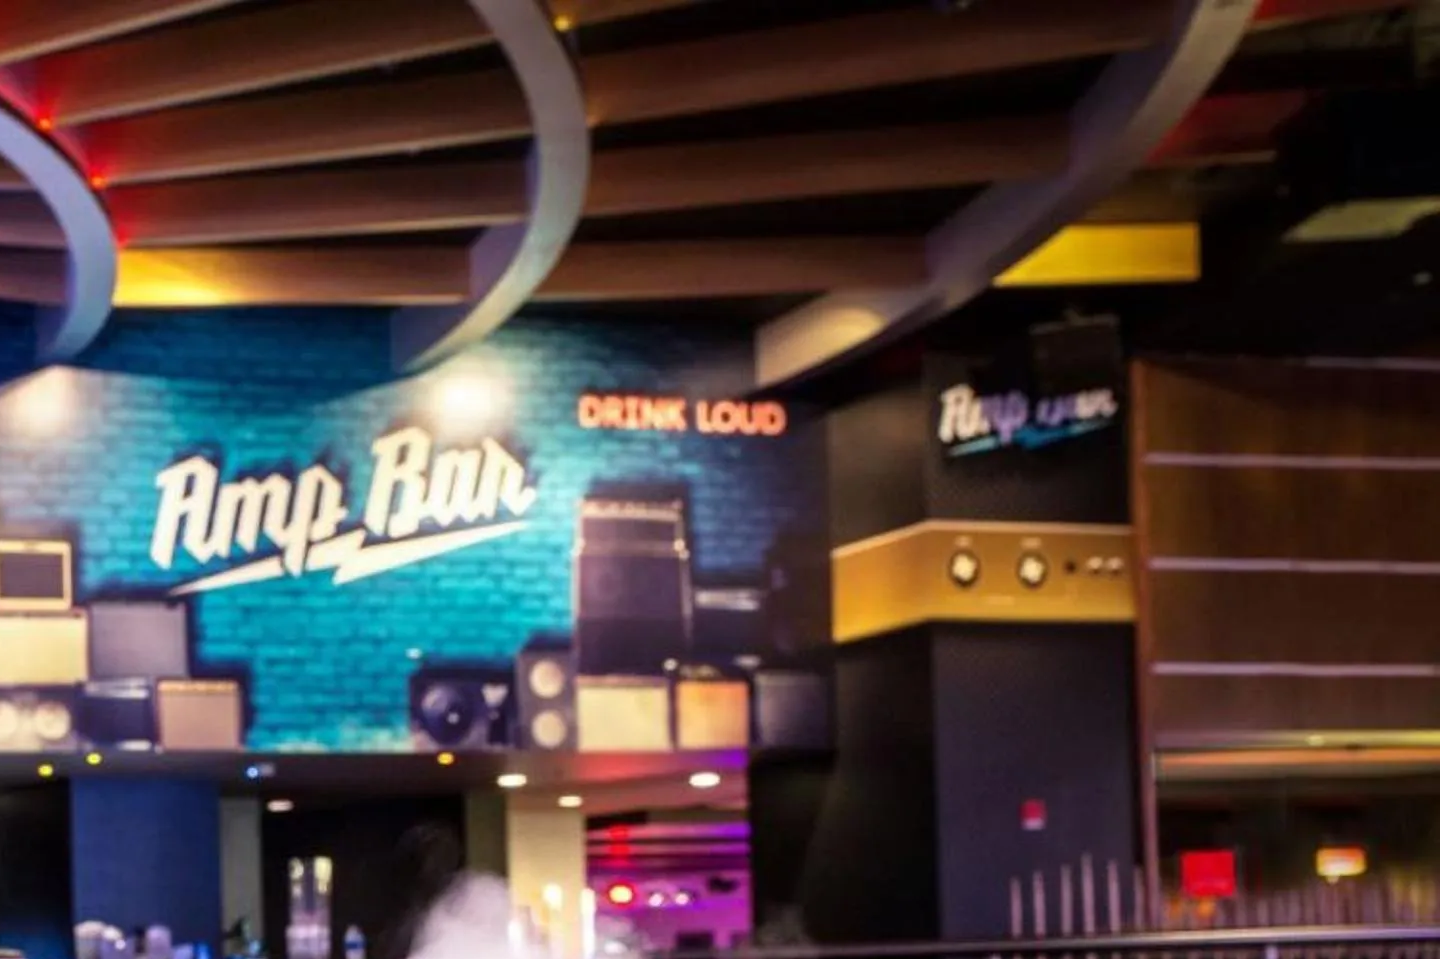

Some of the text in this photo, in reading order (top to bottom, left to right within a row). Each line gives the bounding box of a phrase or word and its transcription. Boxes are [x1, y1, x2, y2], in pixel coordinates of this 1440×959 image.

[577, 394, 788, 436] DRINK LOUD
[150, 426, 537, 577] Amp Bar
